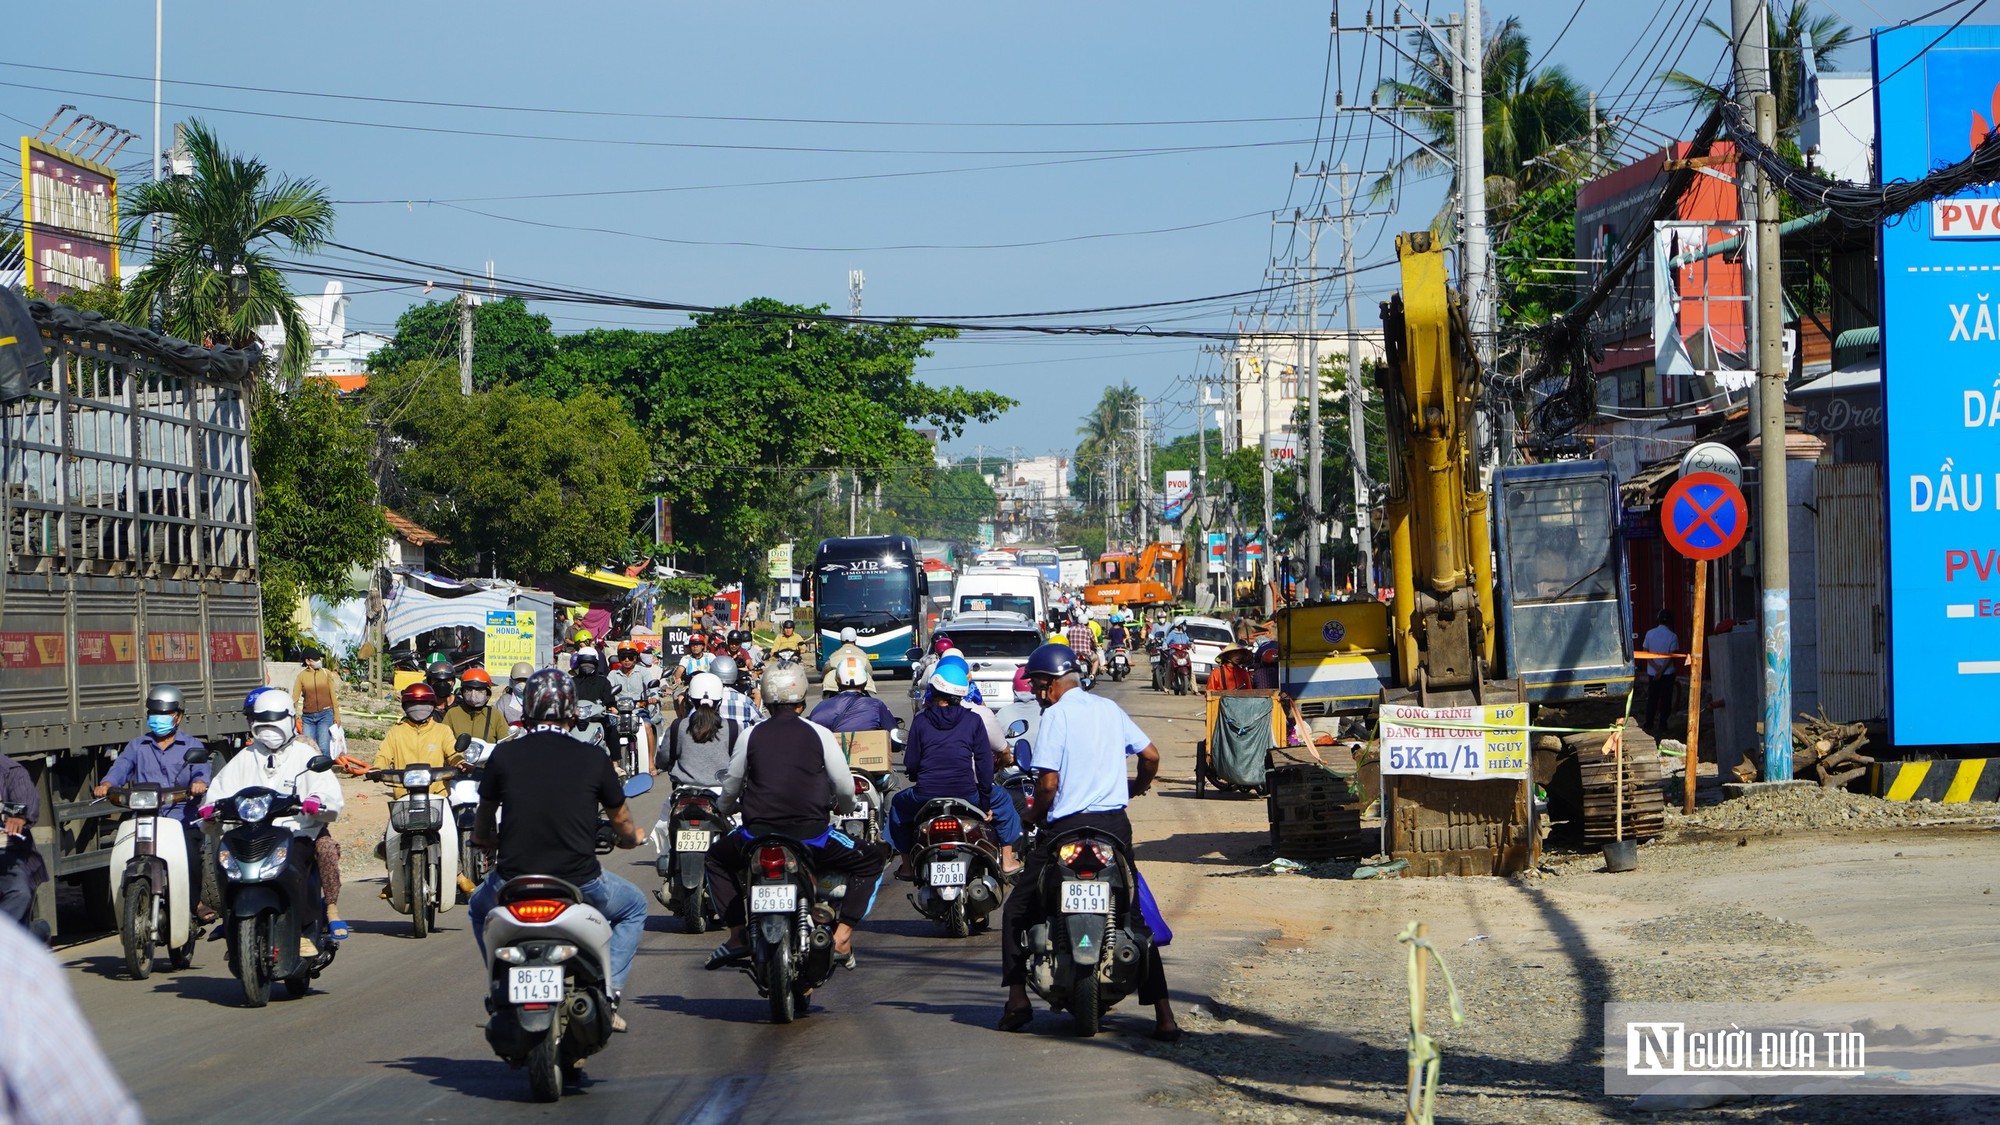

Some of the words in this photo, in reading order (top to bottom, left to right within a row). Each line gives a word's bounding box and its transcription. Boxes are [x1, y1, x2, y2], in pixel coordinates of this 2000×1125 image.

[1949, 293, 2000, 341] XĂ
[1695, 452, 1738, 475] Dream
[1910, 457, 1983, 512] DẦU
[1946, 549, 2000, 582] PV
[671, 644, 684, 655] XE
[1396, 706, 1429, 719] CÔNG
[1434, 708, 1472, 719] TRÌNH
[1495, 705, 1514, 719] HỐ
[1386, 727, 1421, 738] ĐANG
[1424, 727, 1445, 737] THI
[1488, 742, 1523, 752] NGUY
[1390, 745, 1480, 773] 5Km/h
[1488, 754, 1523, 768] HIỂM
[681, 832, 705, 841] 86-C1
[677, 841, 708, 850] 923.77
[936, 863, 960, 874] 86-C1
[933, 873, 964, 884] 270.80
[758, 887, 789, 897] 86-C1
[1069, 884, 1101, 896] 86-C1
[753, 899, 793, 910] 629.69
[1064, 897, 1106, 911] 491.91
[517, 969, 554, 983] 86-C2
[513, 985, 559, 999] 114.91
